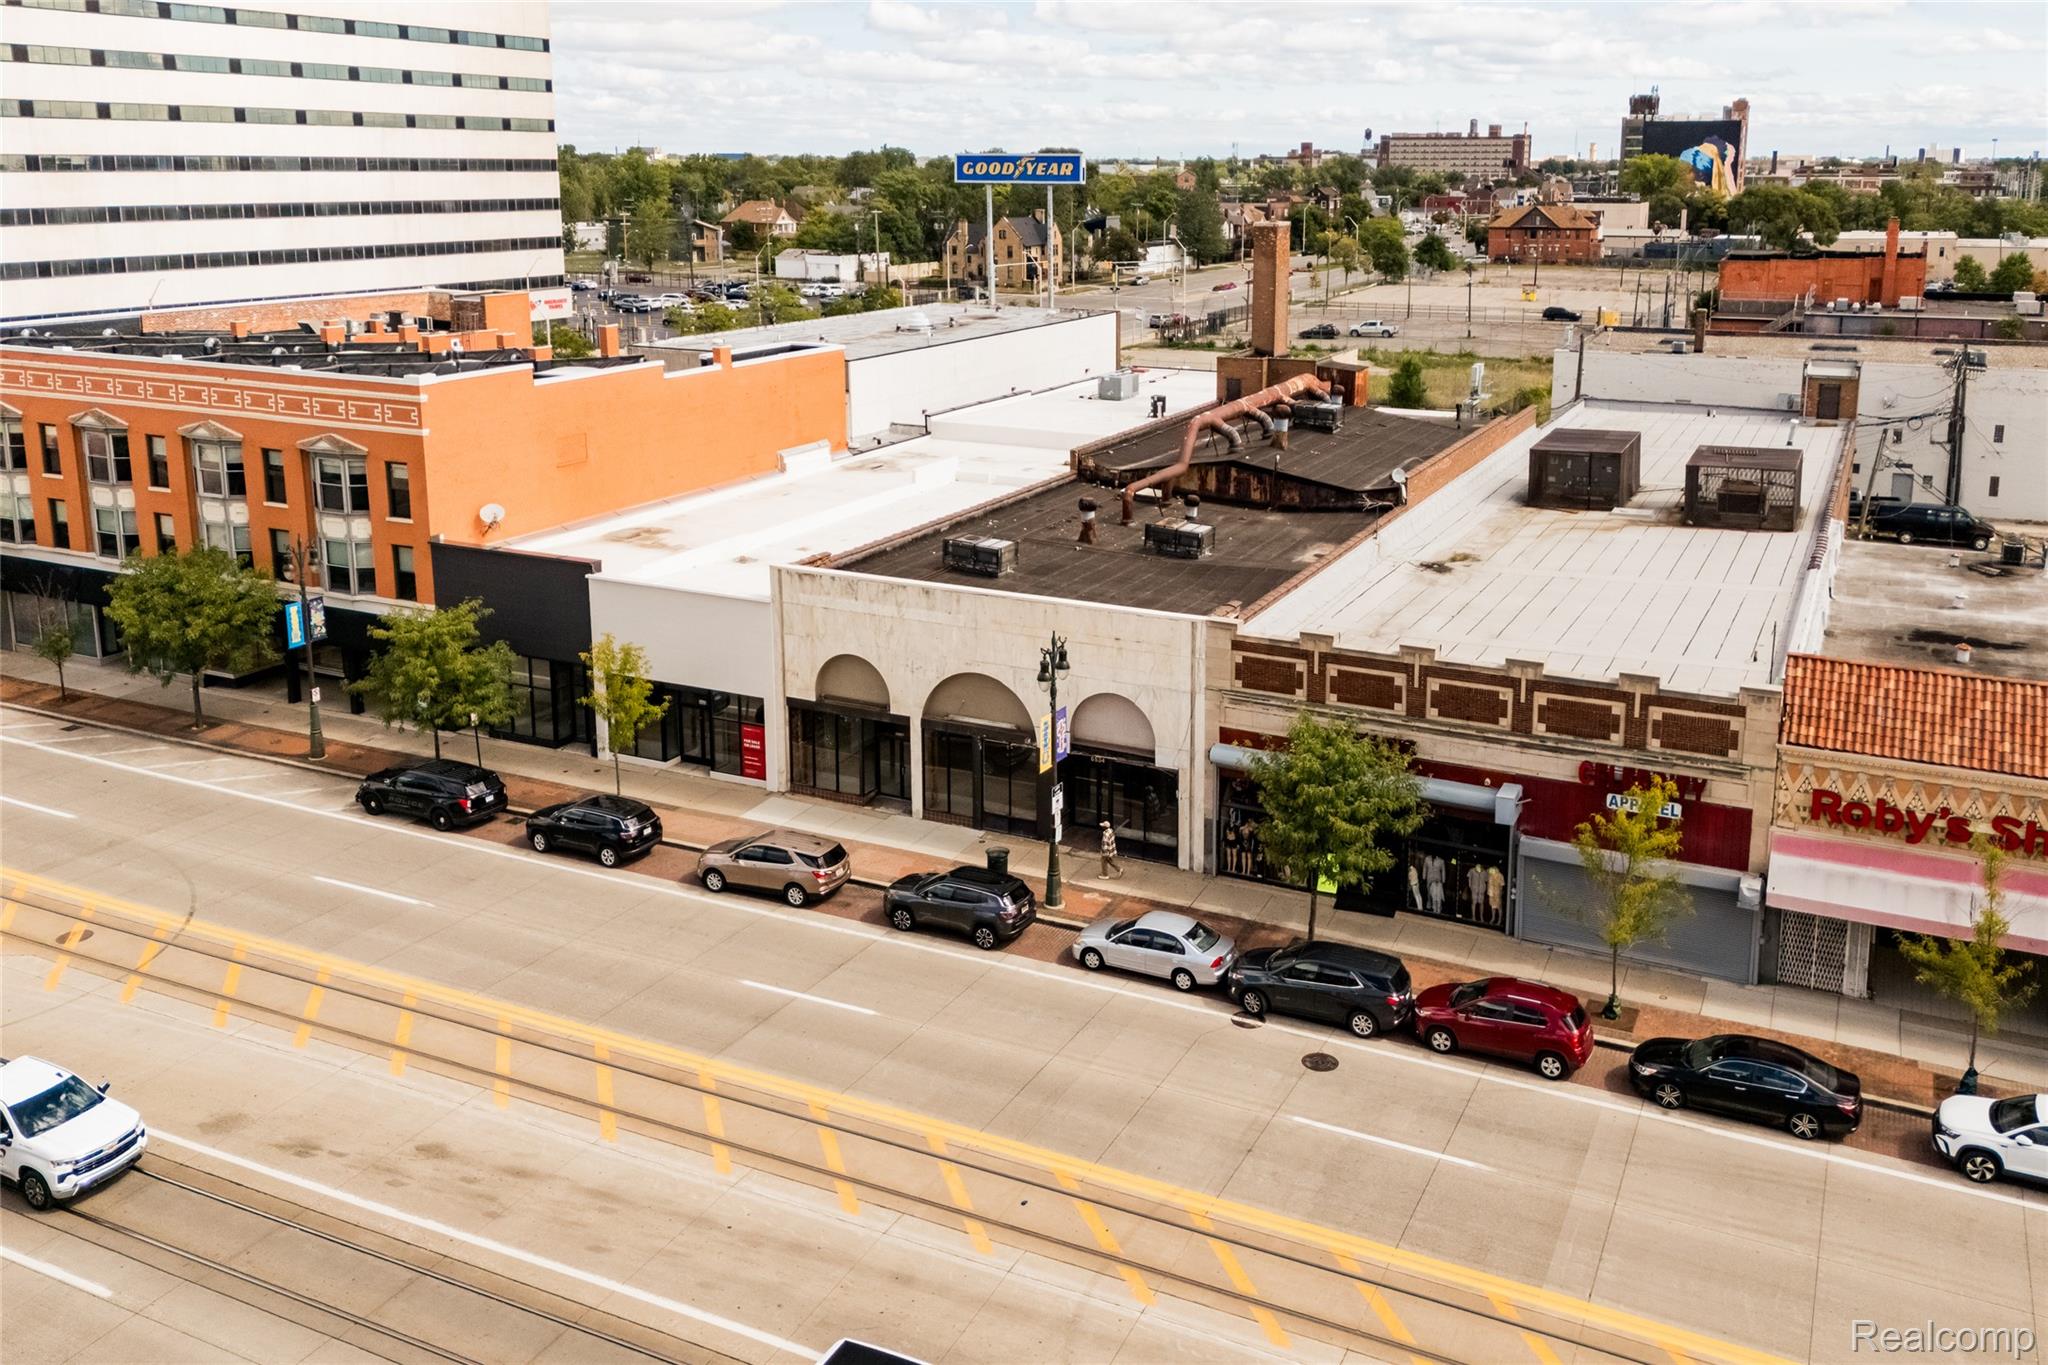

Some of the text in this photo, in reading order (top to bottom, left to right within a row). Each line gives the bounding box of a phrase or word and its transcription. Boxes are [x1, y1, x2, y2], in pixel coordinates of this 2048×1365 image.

[962, 161, 1074, 176] GOODYEAR
[1608, 794, 1679, 818] APPEL
[1810, 788, 1972, 844] Roby's
